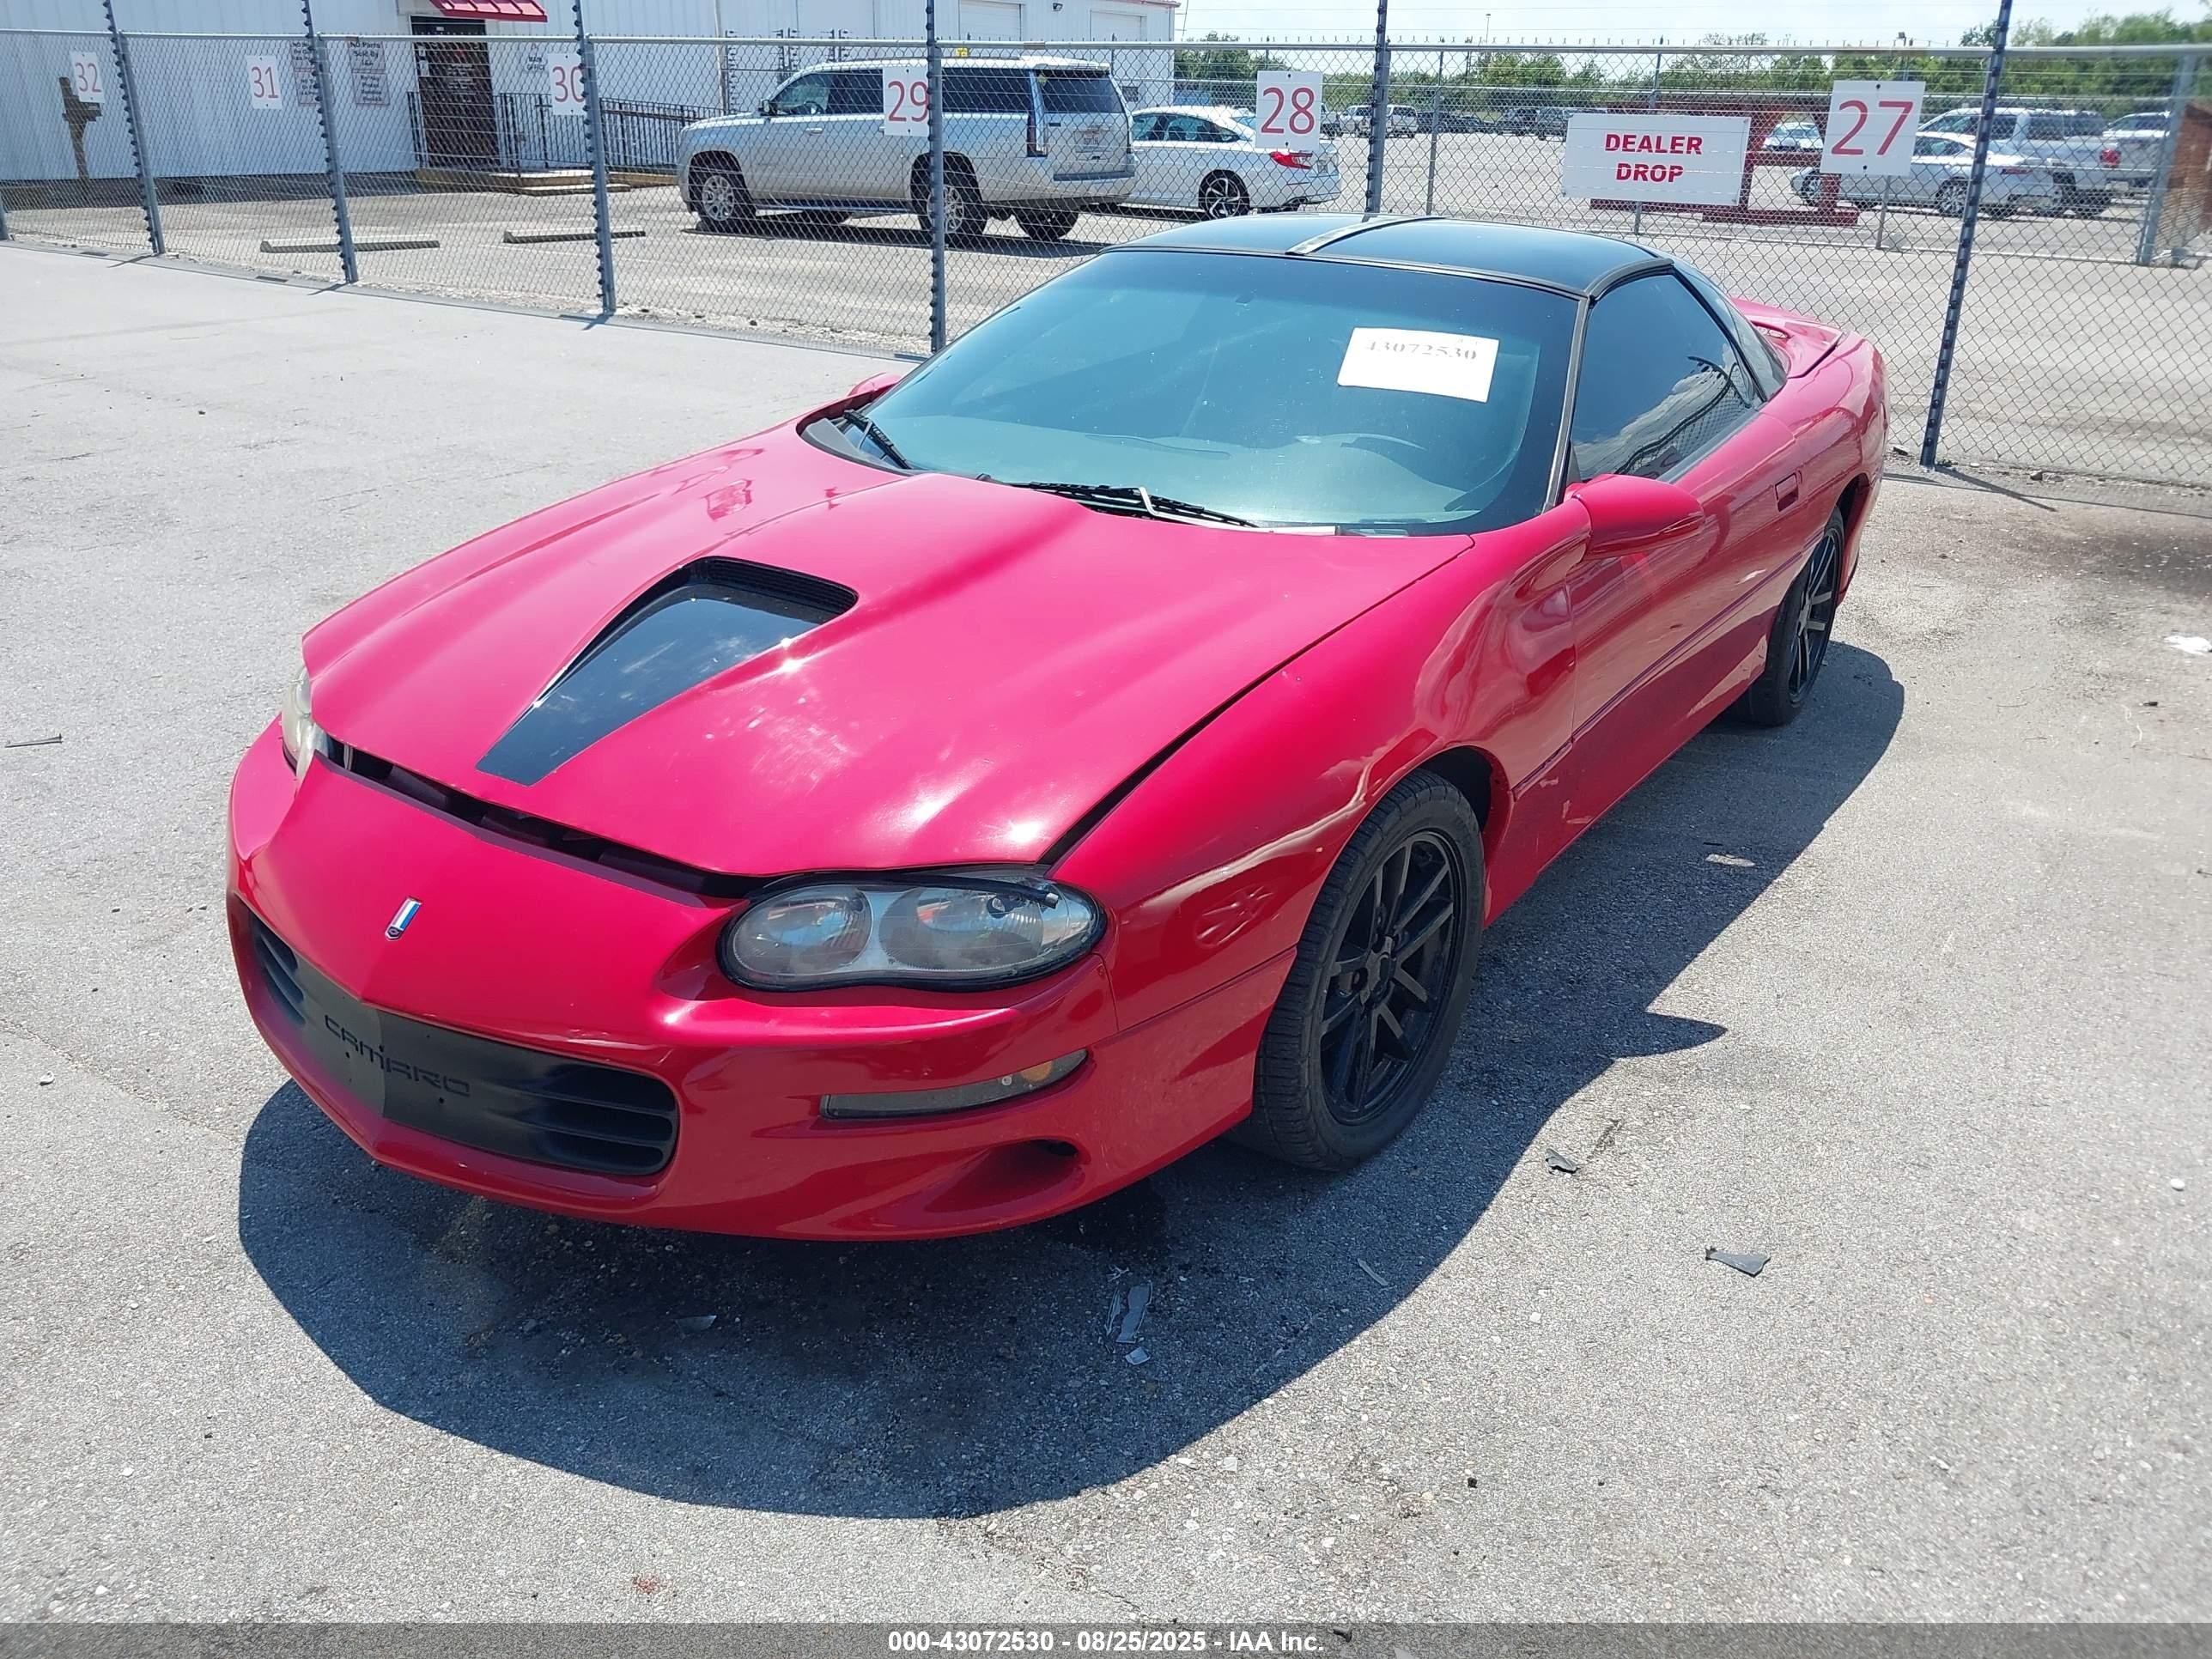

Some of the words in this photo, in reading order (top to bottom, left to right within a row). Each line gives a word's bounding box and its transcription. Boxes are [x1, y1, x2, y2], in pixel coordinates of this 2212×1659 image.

[75, 62, 102, 93] 32
[251, 66, 279, 99] 31
[888, 81, 930, 122] 29
[1261, 87, 1315, 135] 28
[1605, 133, 1703, 155] DEALER
[1831, 100, 1913, 155] 27
[1616, 162, 1684, 183] DROP
[1364, 340, 1478, 361] 43072530
[324, 1013, 471, 1098] CAMARO
